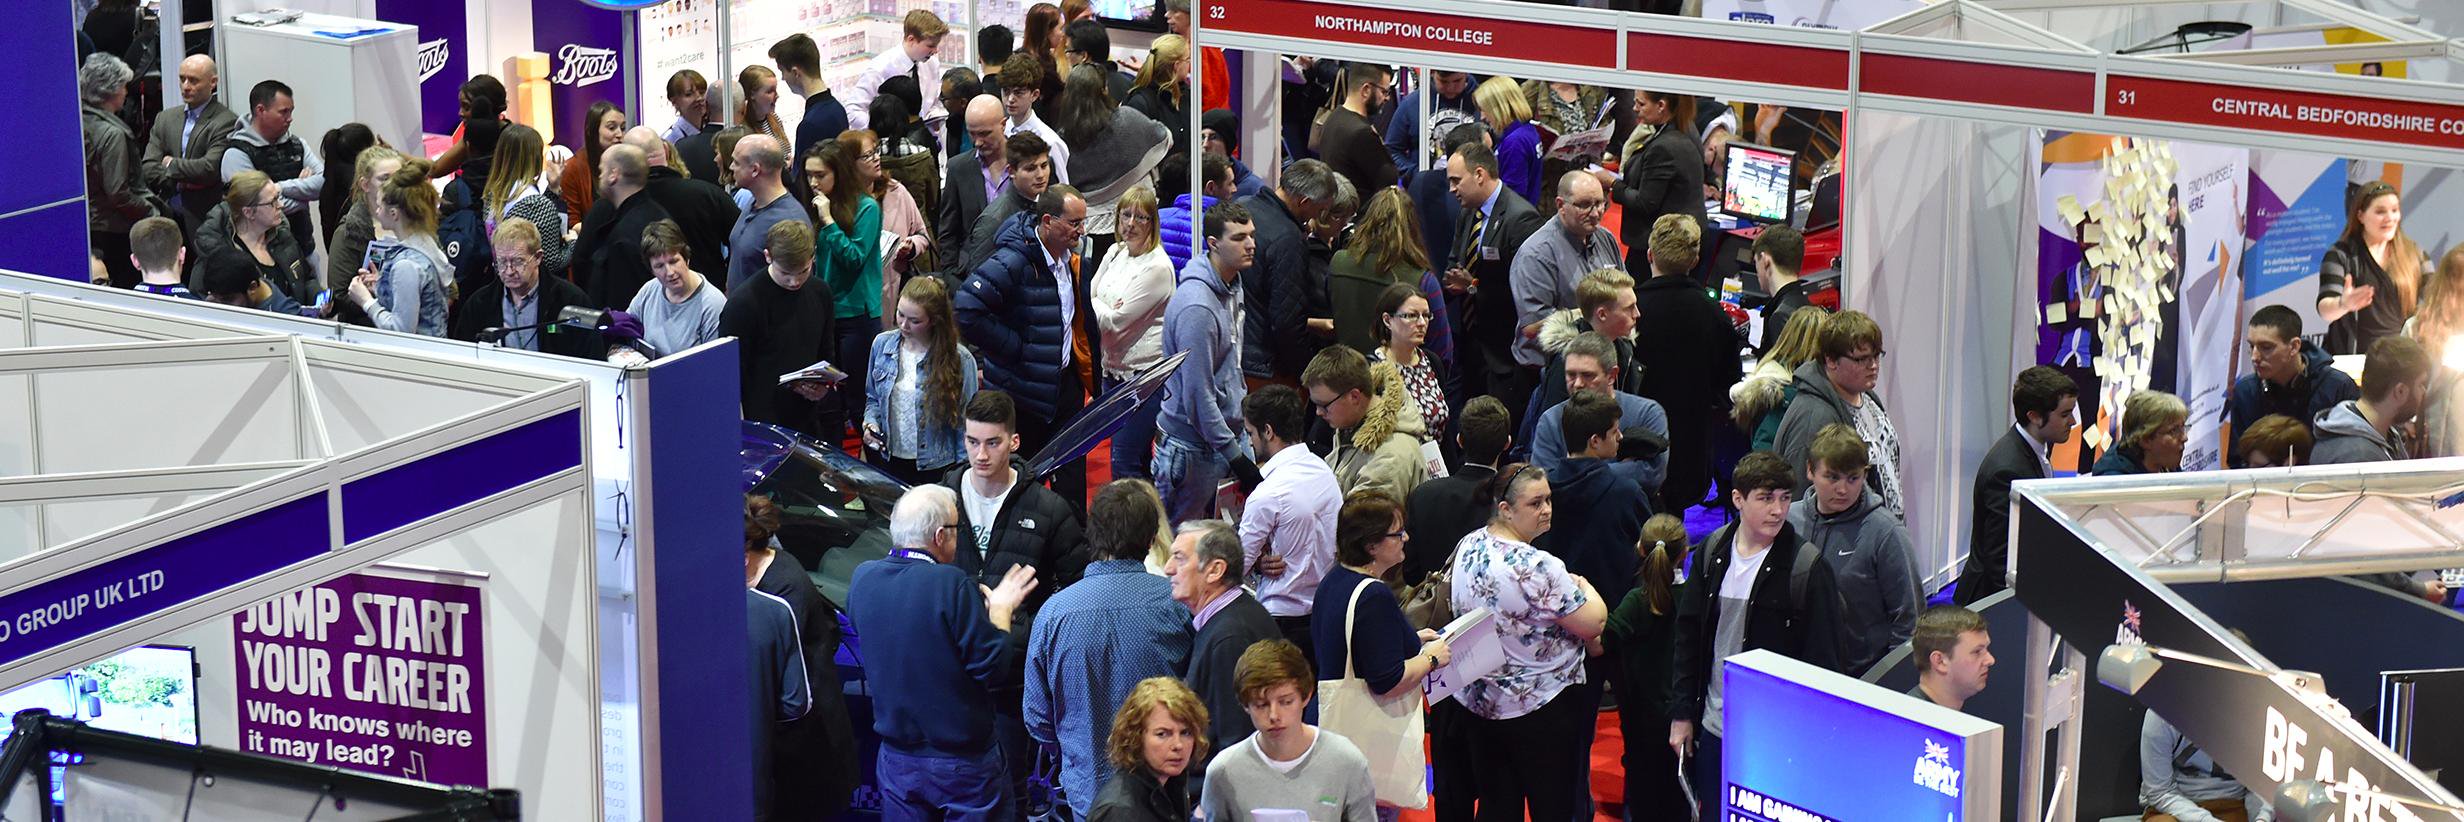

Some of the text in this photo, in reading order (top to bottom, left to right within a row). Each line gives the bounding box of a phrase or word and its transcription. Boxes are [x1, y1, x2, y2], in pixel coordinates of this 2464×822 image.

[1209, 6, 1225, 19] 32
[1315, 15, 1493, 46] NORTHAMPTON COLLEGE
[552, 44, 618, 87] Boots
[2118, 91, 2136, 105] 31
[2212, 97, 2292, 120] CENTRAL
[2297, 106, 2434, 132] BEDFORDSHIRE
[16, 593, 90, 636] GROUP
[95, 582, 124, 609] UK
[128, 569, 165, 599] LTD
[352, 592, 469, 657] START
[242, 640, 472, 714] YOUR CAREER
[246, 699, 473, 748] Who knows where
[248, 729, 395, 767] it may lead?
[1729, 785, 1736, 805] I
[1737, 789, 1762, 815] AM
